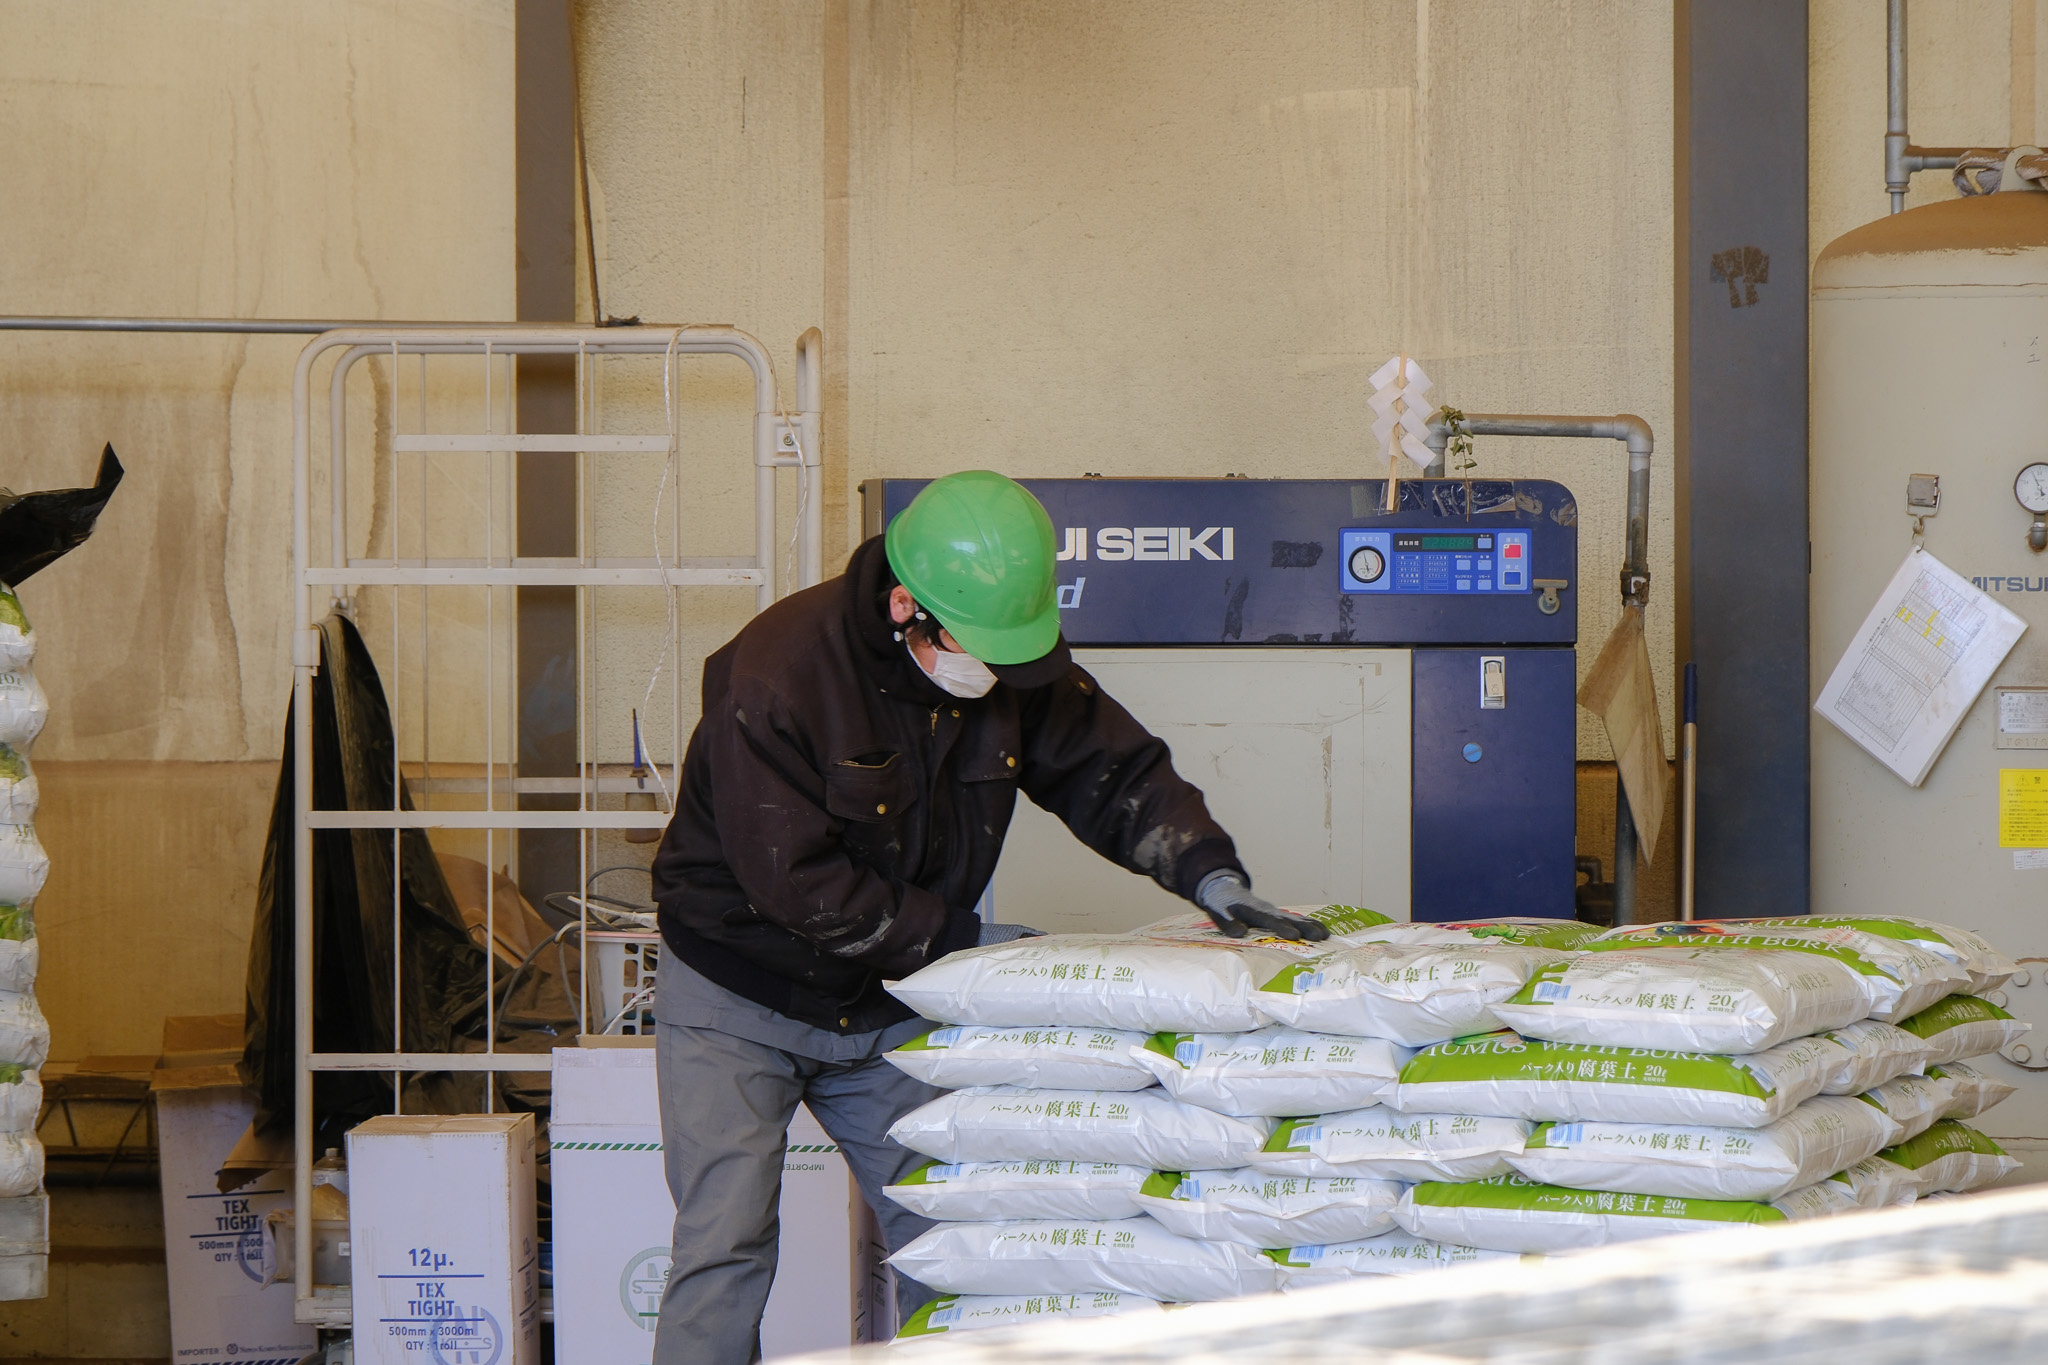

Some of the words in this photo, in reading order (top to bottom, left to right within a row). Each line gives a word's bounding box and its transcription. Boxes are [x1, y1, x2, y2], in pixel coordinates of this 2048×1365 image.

[1096, 527, 1234, 561] SEIKI
[1677, 933, 1750, 945] WITH
[222, 1200, 250, 1215] TEX
[215, 1215, 259, 1231] TIGHT
[198, 1241, 234, 1250] 500mm
[214, 1253, 232, 1262] QTY
[416, 1283, 445, 1298] TEX
[408, 1300, 455, 1316] TIGHT
[388, 1326, 427, 1336] 500mm
[438, 1326, 474, 1336] 3000m
[405, 1341, 425, 1350] QTY
